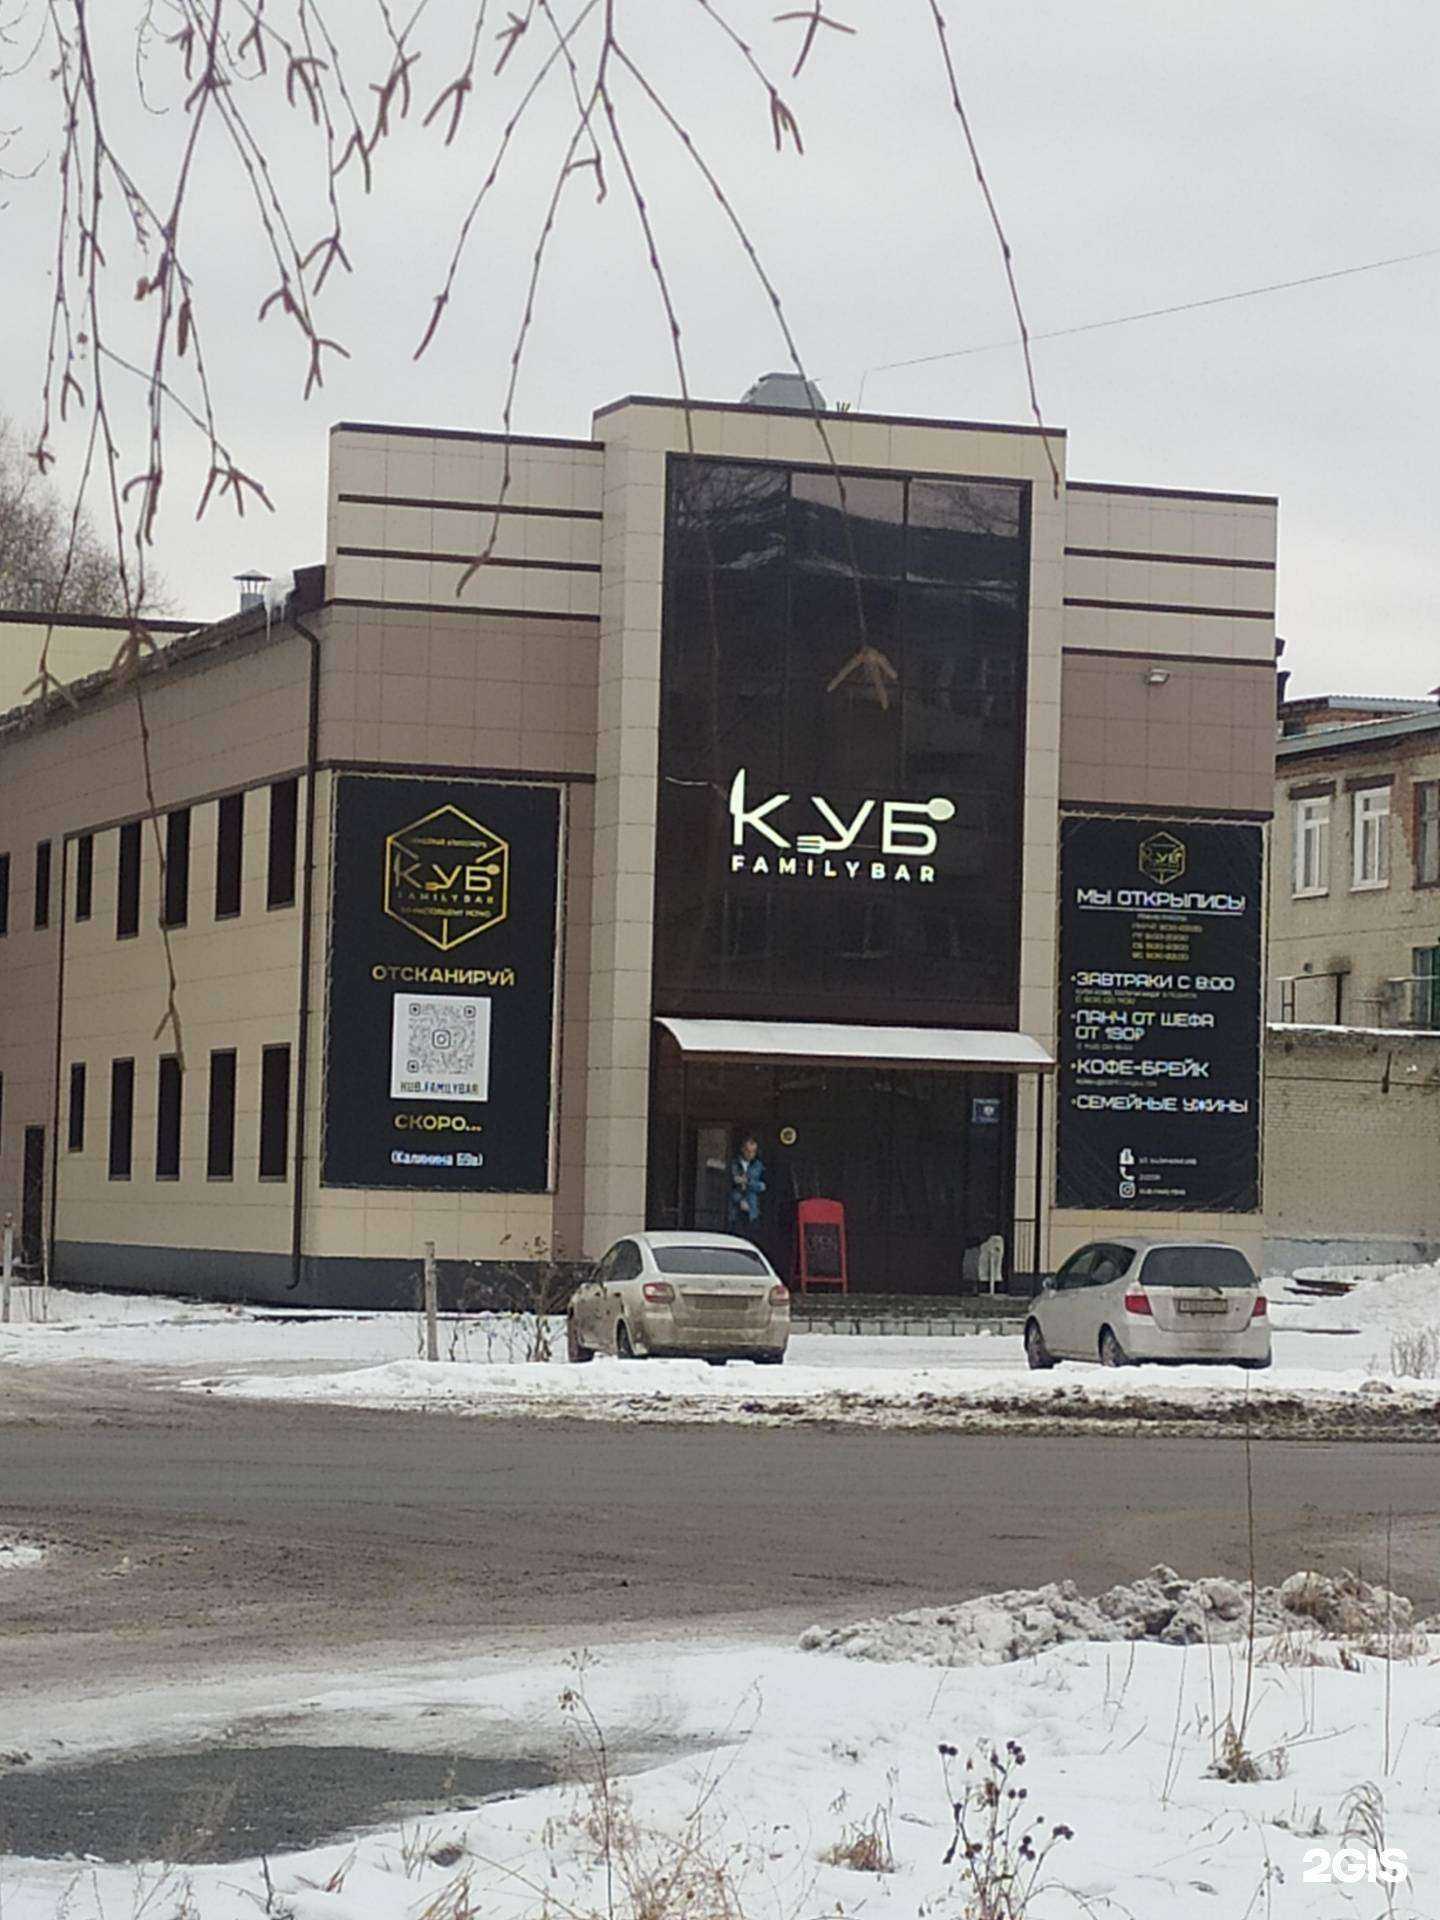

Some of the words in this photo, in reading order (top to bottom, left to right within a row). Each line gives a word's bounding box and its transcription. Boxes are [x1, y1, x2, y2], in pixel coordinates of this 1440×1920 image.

[731, 854, 935, 883] FAMILYBAR
[372, 964, 515, 987] ОТСКАНИРУЙ
[1131, 1012, 1155, 1026] ОТ
[1160, 1013, 1215, 1028] ШЕФА
[1075, 1026, 1099, 1040] ОТ
[1076, 1058, 1210, 1078] КОФЕ-БРЕЙК
[1076, 1094, 1179, 1112] СЕМЕЙНЫЕ
[1183, 1099, 1248, 1113] УЖИНЫ
[394, 1114, 482, 1132] СКОРО...
